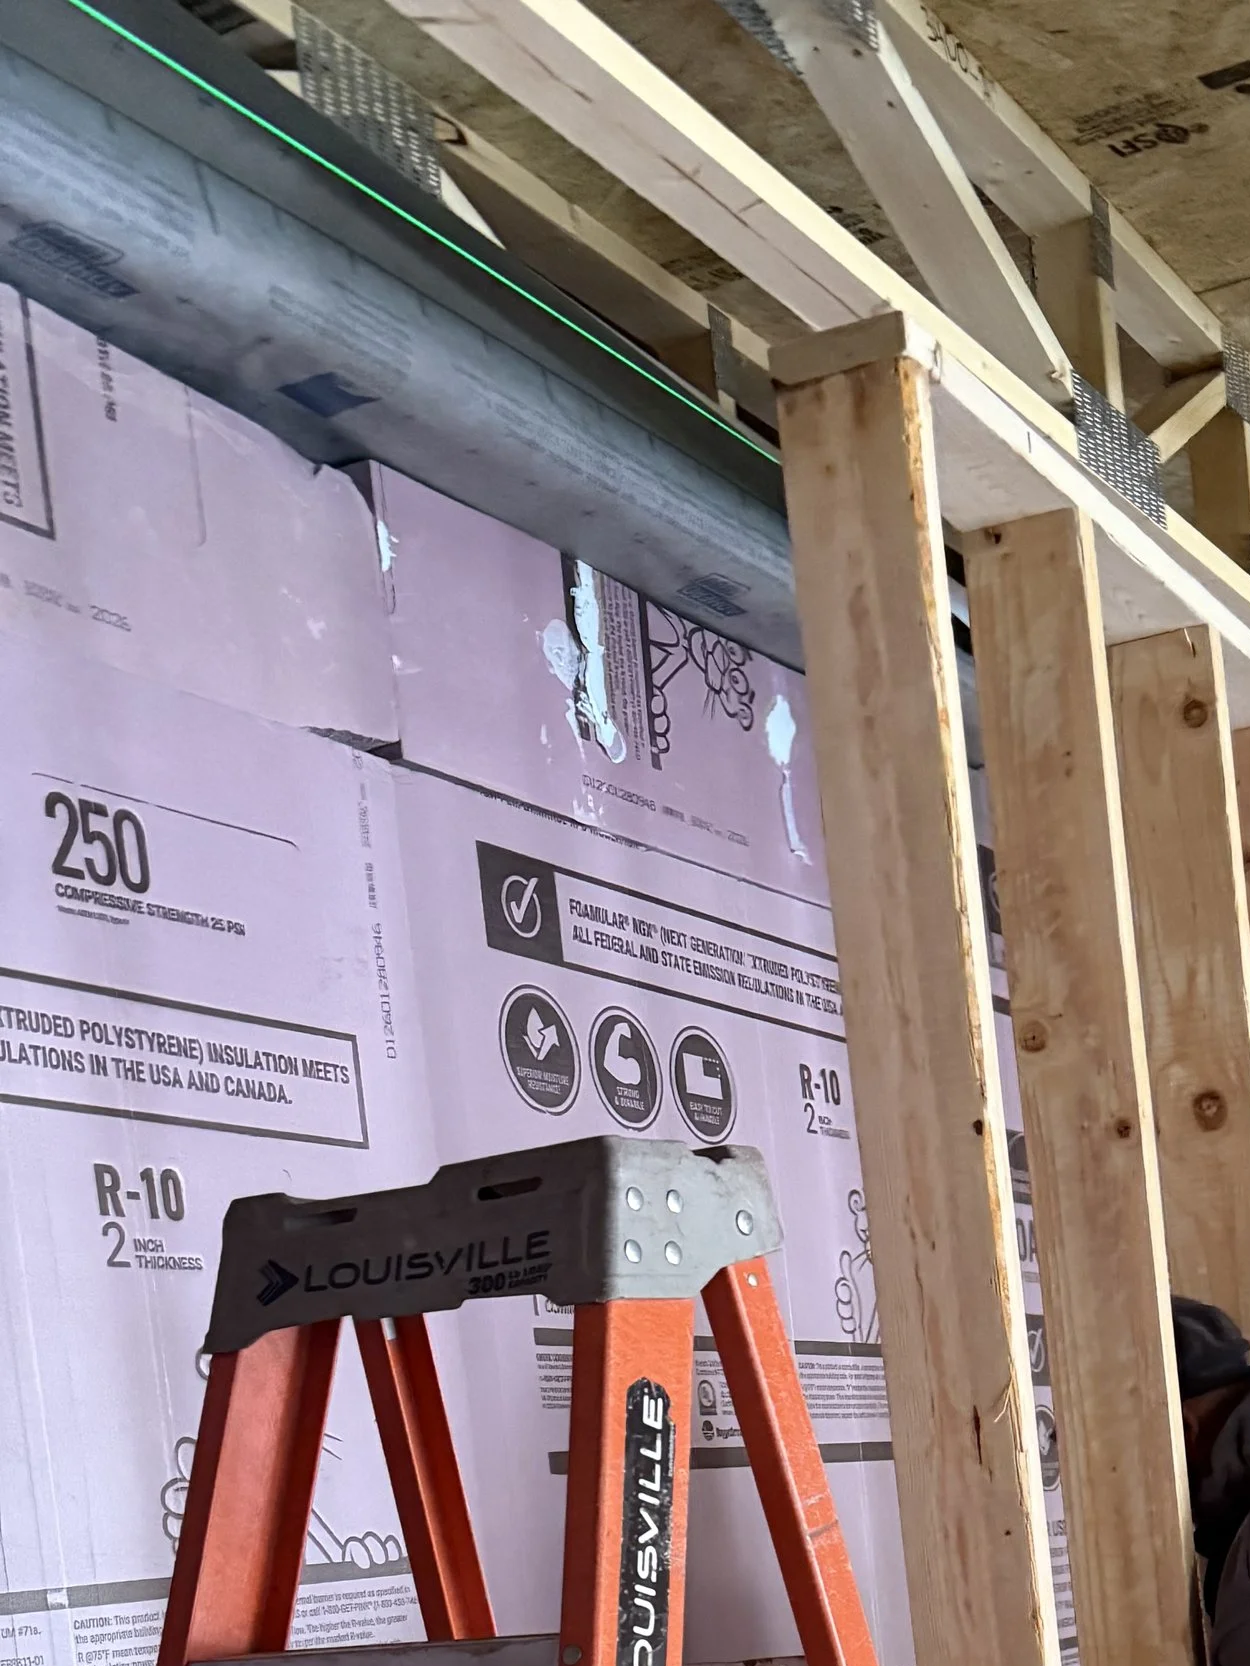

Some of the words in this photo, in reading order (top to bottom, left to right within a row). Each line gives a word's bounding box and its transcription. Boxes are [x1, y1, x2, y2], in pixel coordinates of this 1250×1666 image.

[44, 791, 151, 894] 250
[54, 882, 146, 917] COMPRESSIVE
[146, 902, 210, 929] STRENGTH
[210, 916, 226, 932] 25
[594, 931, 639, 960] FEDERAL
[639, 943, 660, 965] AND
[661, 950, 692, 974] STATE
[692, 959, 737, 987] EMISSION
[660, 925, 688, 951] (NEXT
[0, 1005, 75, 1040] TRUDED
[79, 1018, 205, 1066] POLYSTYRENE)
[207, 1041, 300, 1077] INSULATION
[302, 1057, 351, 1085] MEETS
[0, 1039, 86, 1075] LATIONS
[90, 1054, 109, 1078] IN
[112, 1057, 147, 1084] THE
[150, 1063, 184, 1090] USA
[187, 1071, 221, 1095] AND
[223, 1075, 294, 1106] CANADA.
[799, 1062, 842, 1107] R-10
[803, 1101, 820, 1135] 2
[94, 1162, 187, 1222] R-10
[102, 1221, 132, 1269] 2
[133, 1237, 165, 1254] INCH
[135, 1255, 204, 1272] THICKNESS
[303, 1230, 552, 1293] LOUISVILLE
[467, 1271, 507, 1297] 300
[73, 1616, 114, 1631] CAUTION:
[114, 1614, 131, 1627] This
[75, 1633, 89, 1645] the
[77, 1651, 85, 1664] R
